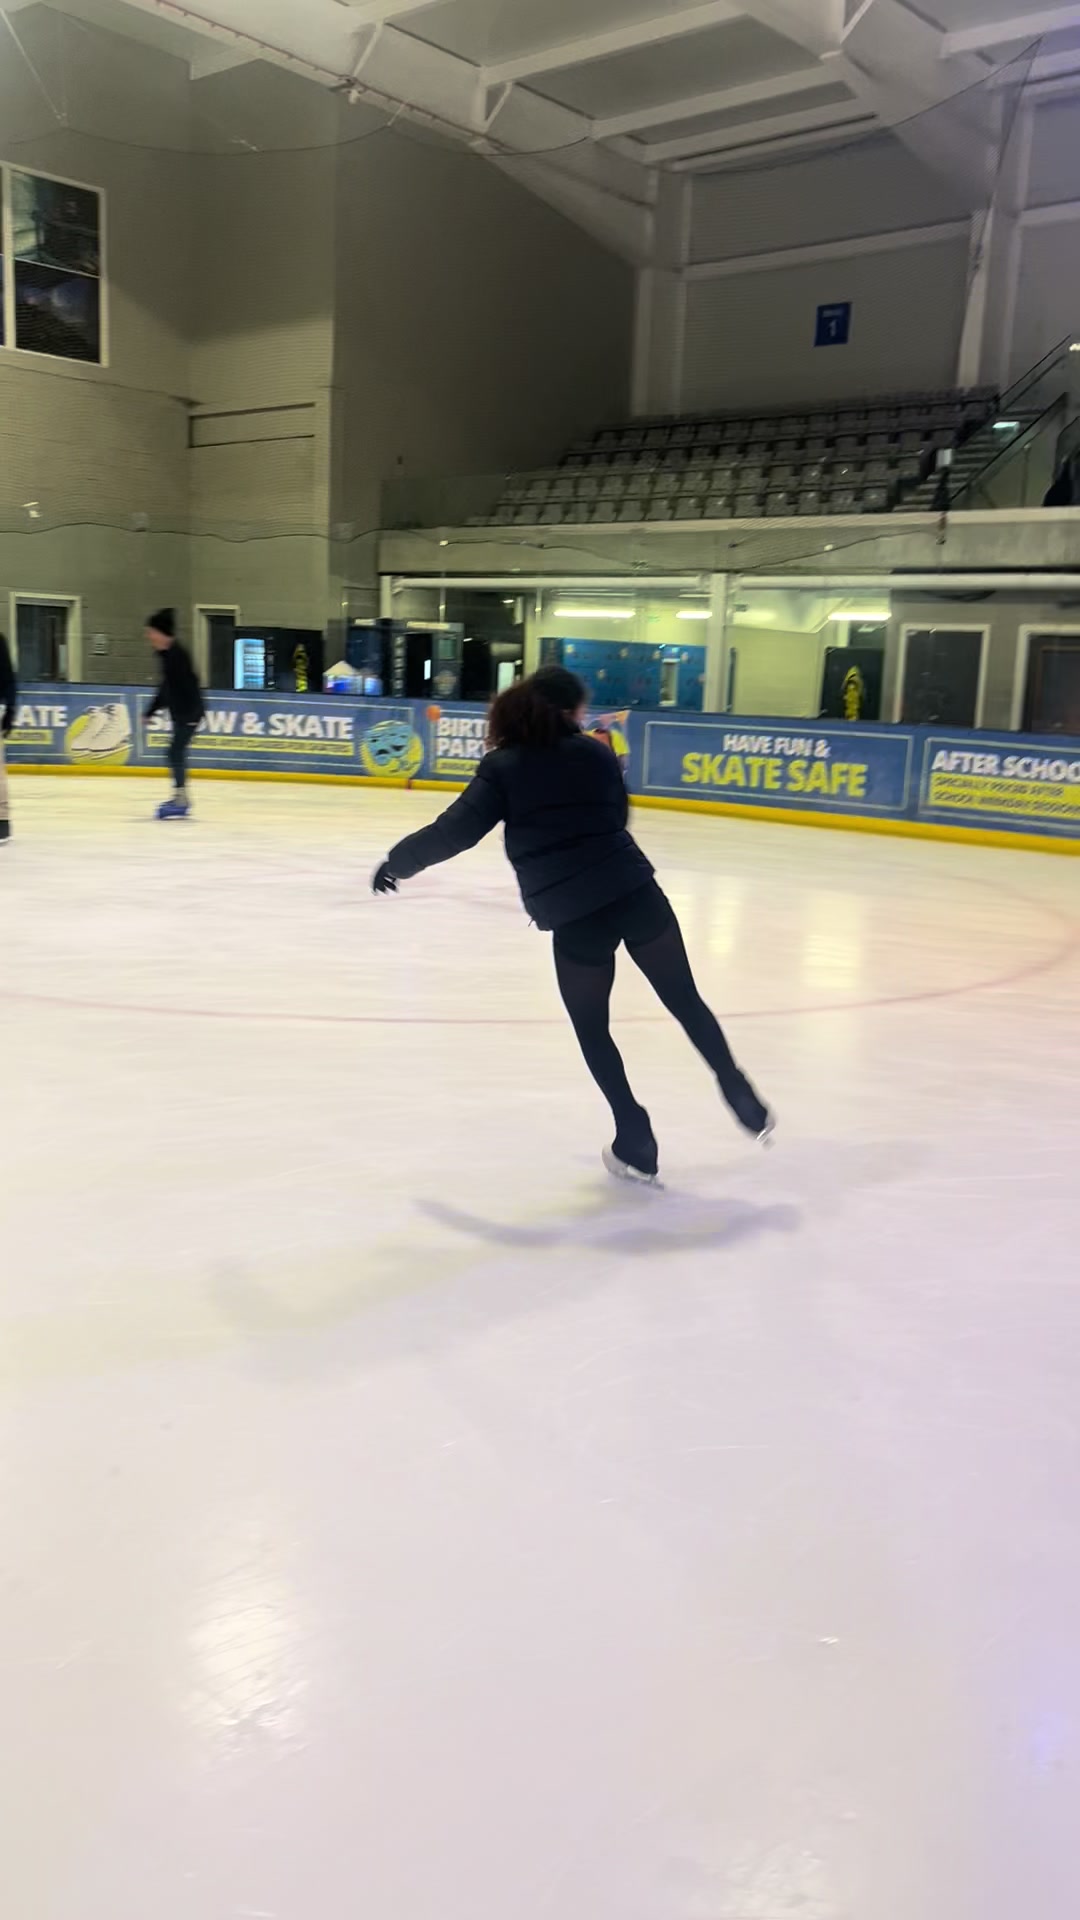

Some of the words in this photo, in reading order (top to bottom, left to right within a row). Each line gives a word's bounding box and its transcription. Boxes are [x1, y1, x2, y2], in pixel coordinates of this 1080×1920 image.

[242, 711, 265, 735] &
[268, 713, 355, 739] SKATE
[723, 734, 773, 754] HAVE
[773, 737, 813, 757] FUN
[813, 739, 832, 758] &
[681, 752, 783, 789] SKATE
[786, 759, 868, 797] SAFE
[931, 750, 1000, 775] AFTER
